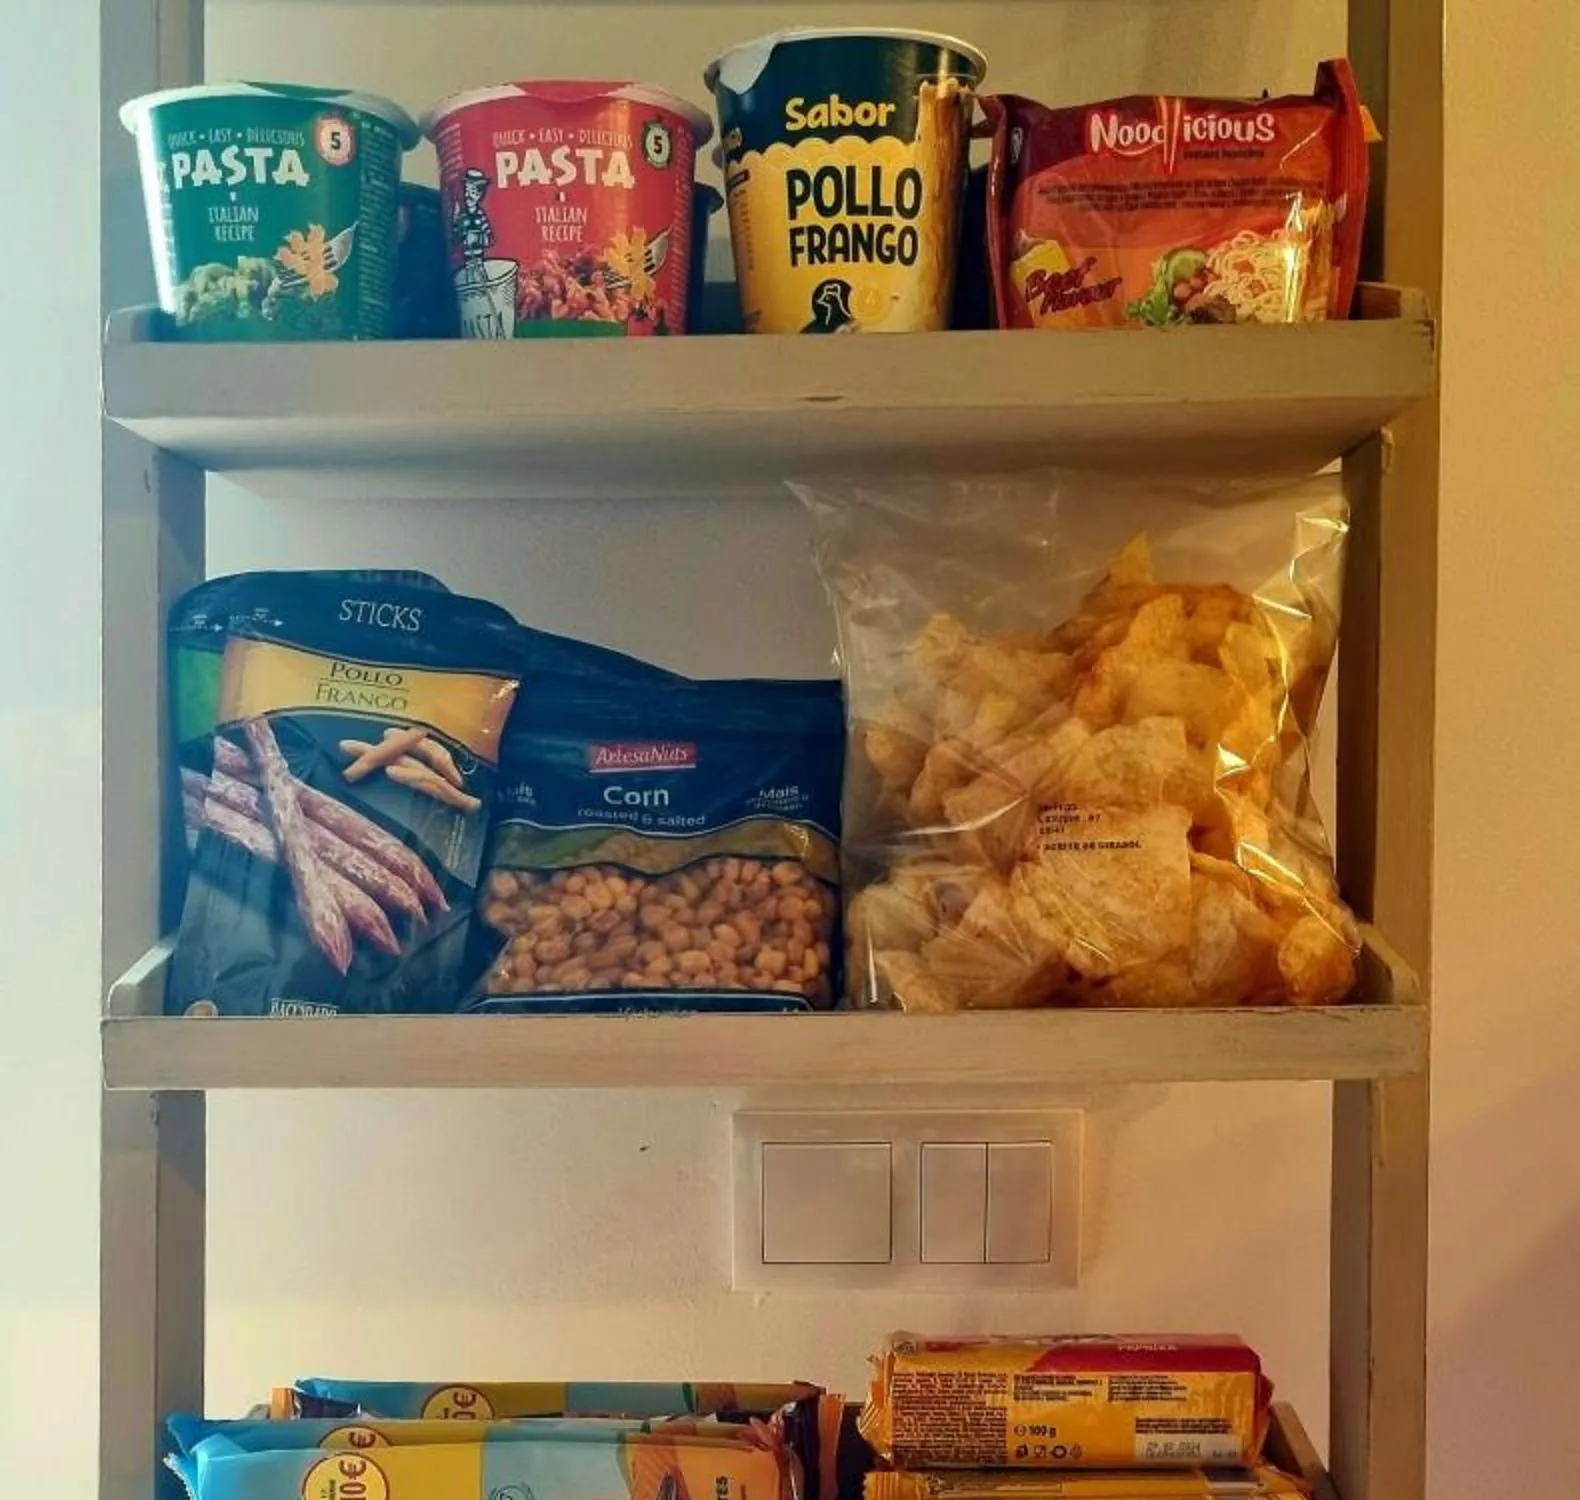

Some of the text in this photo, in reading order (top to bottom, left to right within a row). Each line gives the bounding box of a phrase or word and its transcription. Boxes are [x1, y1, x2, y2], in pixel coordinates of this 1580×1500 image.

[785, 94, 896, 131] Sabor
[330, 132, 341, 150] 5
[538, 128, 564, 143] EASY
[653, 137, 663, 155] 5
[171, 145, 310, 189] PASTA
[495, 145, 636, 189] PASTA
[786, 165, 923, 220] POLLO
[208, 206, 260, 224] ITALIAN
[535, 207, 588, 225] ITALIAN
[214, 225, 255, 242] RECIPE
[541, 225, 584, 243] RECIPE
[789, 222, 920, 267] FRANGO
[338, 600, 424, 632] STICKS
[595, 746, 689, 766] ArtesaNuts
[603, 785, 670, 808] Corn
[577, 806, 638, 822] roasted
[656, 815, 706, 828] salted
